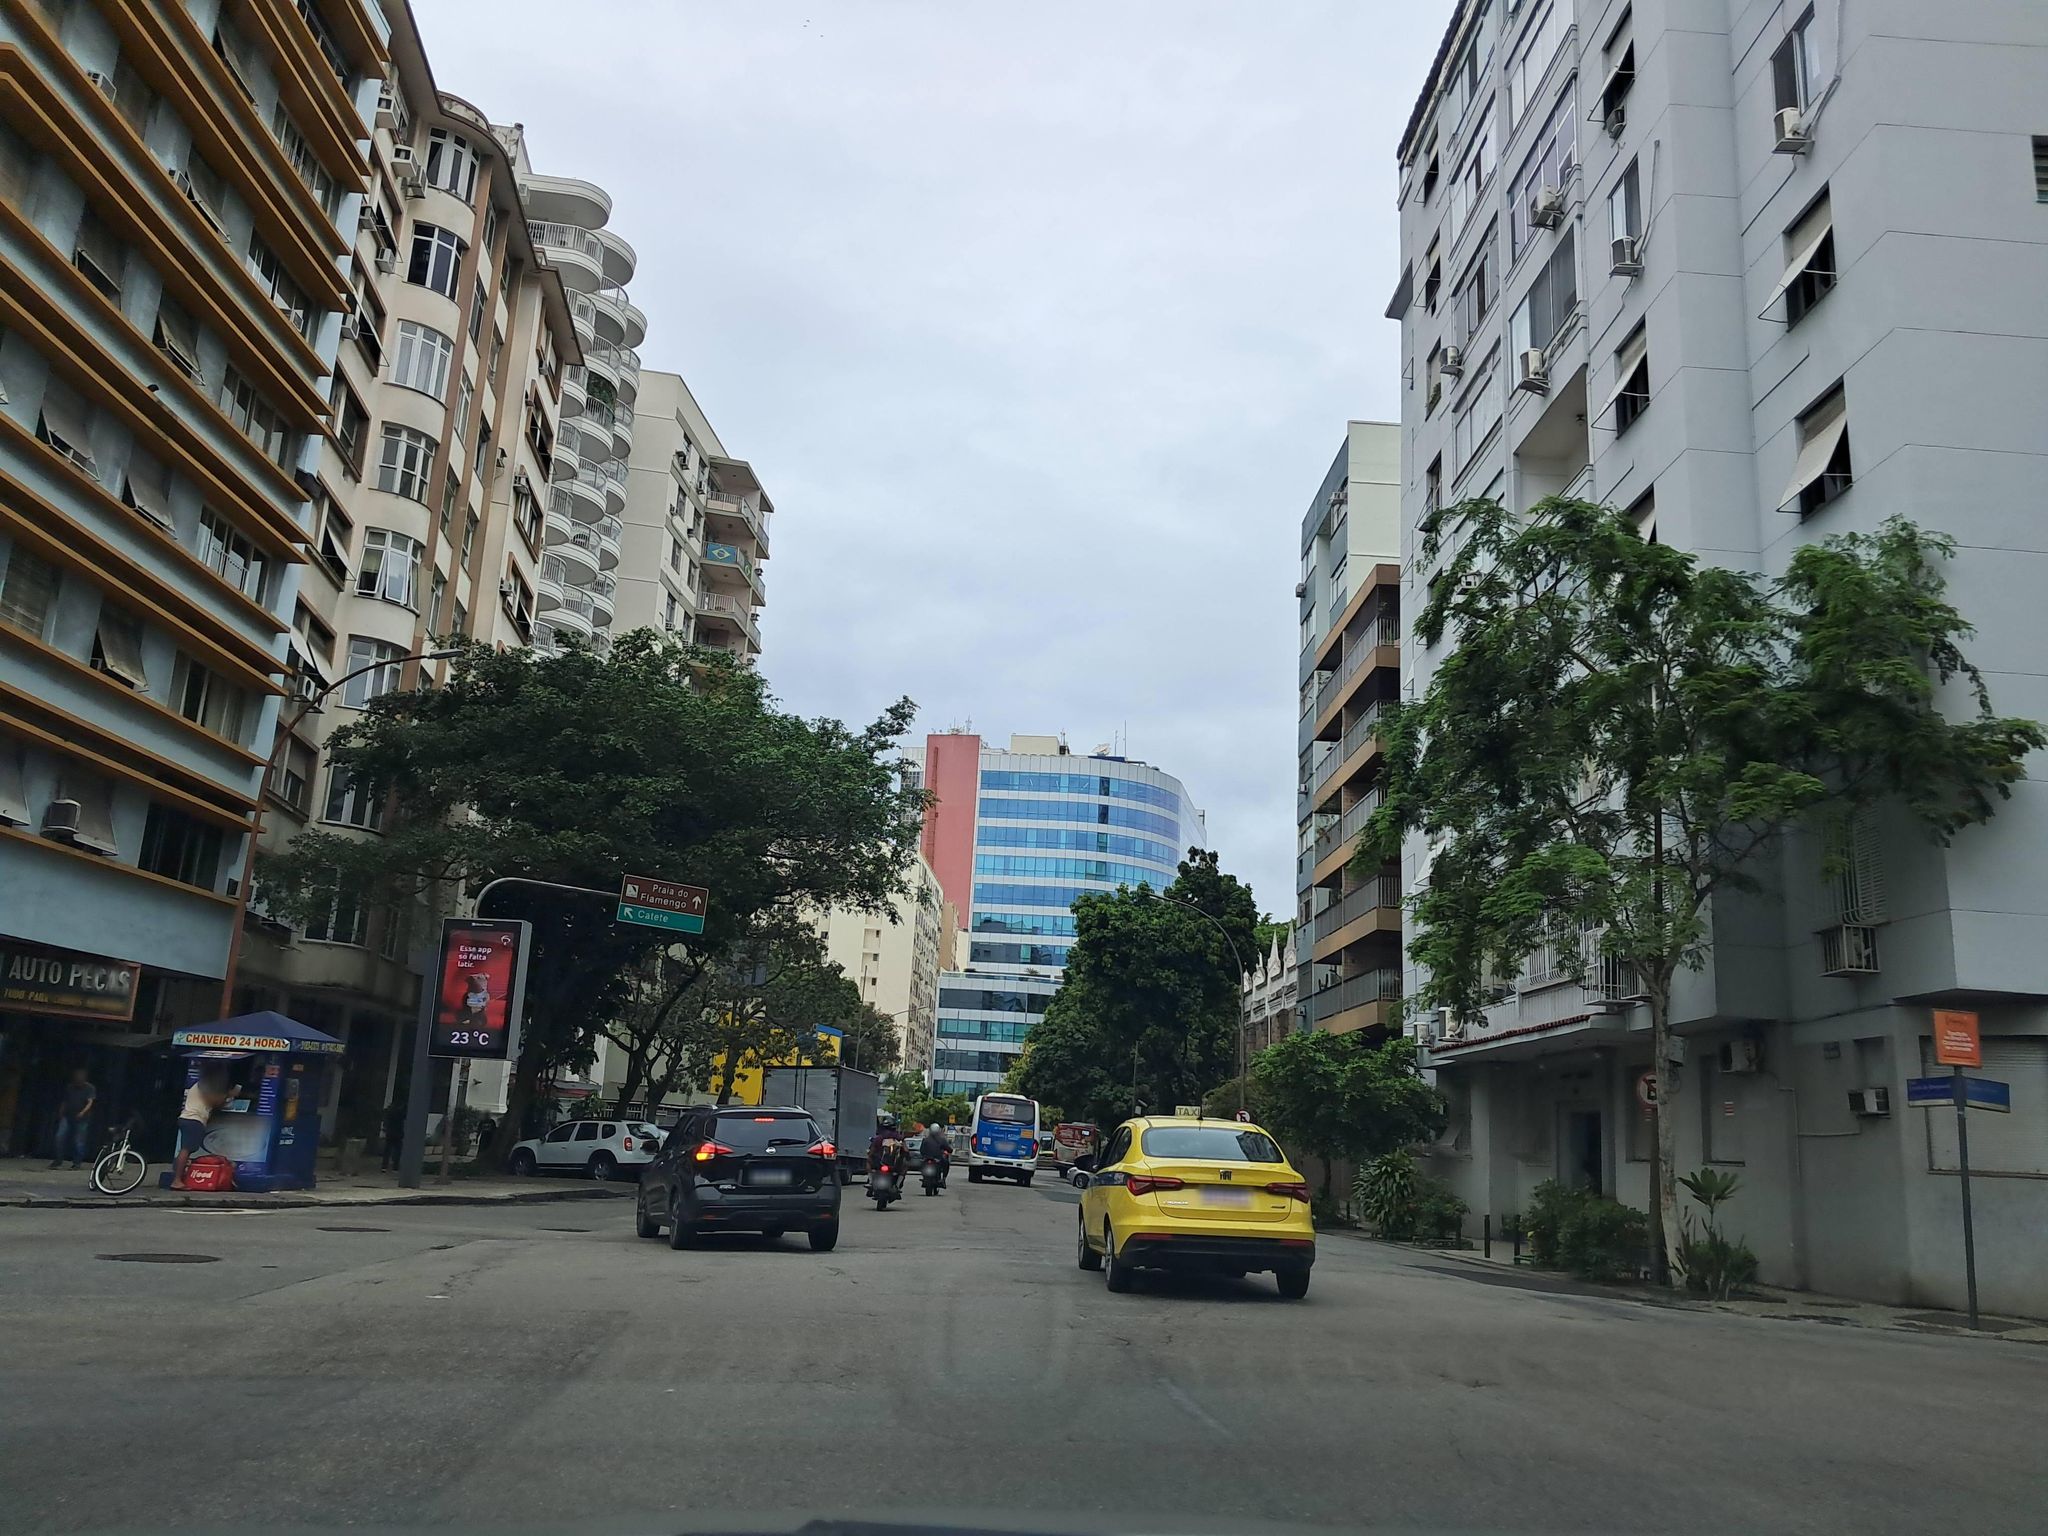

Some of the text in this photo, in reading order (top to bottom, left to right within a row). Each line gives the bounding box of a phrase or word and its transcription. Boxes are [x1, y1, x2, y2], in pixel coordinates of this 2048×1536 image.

[652, 884, 688, 898] Praia do
[640, 893, 687, 909] Flamengo
[638, 911, 668, 922] Catete
[478, 946, 492, 954] app
[8, 955, 63, 985] AUTO
[186, 1033, 236, 1046] CHAVEIRO
[240, 1037, 252, 1047] 24
[450, 1031, 470, 1044] 23
[1177, 1107, 1201, 1116] TAXI
